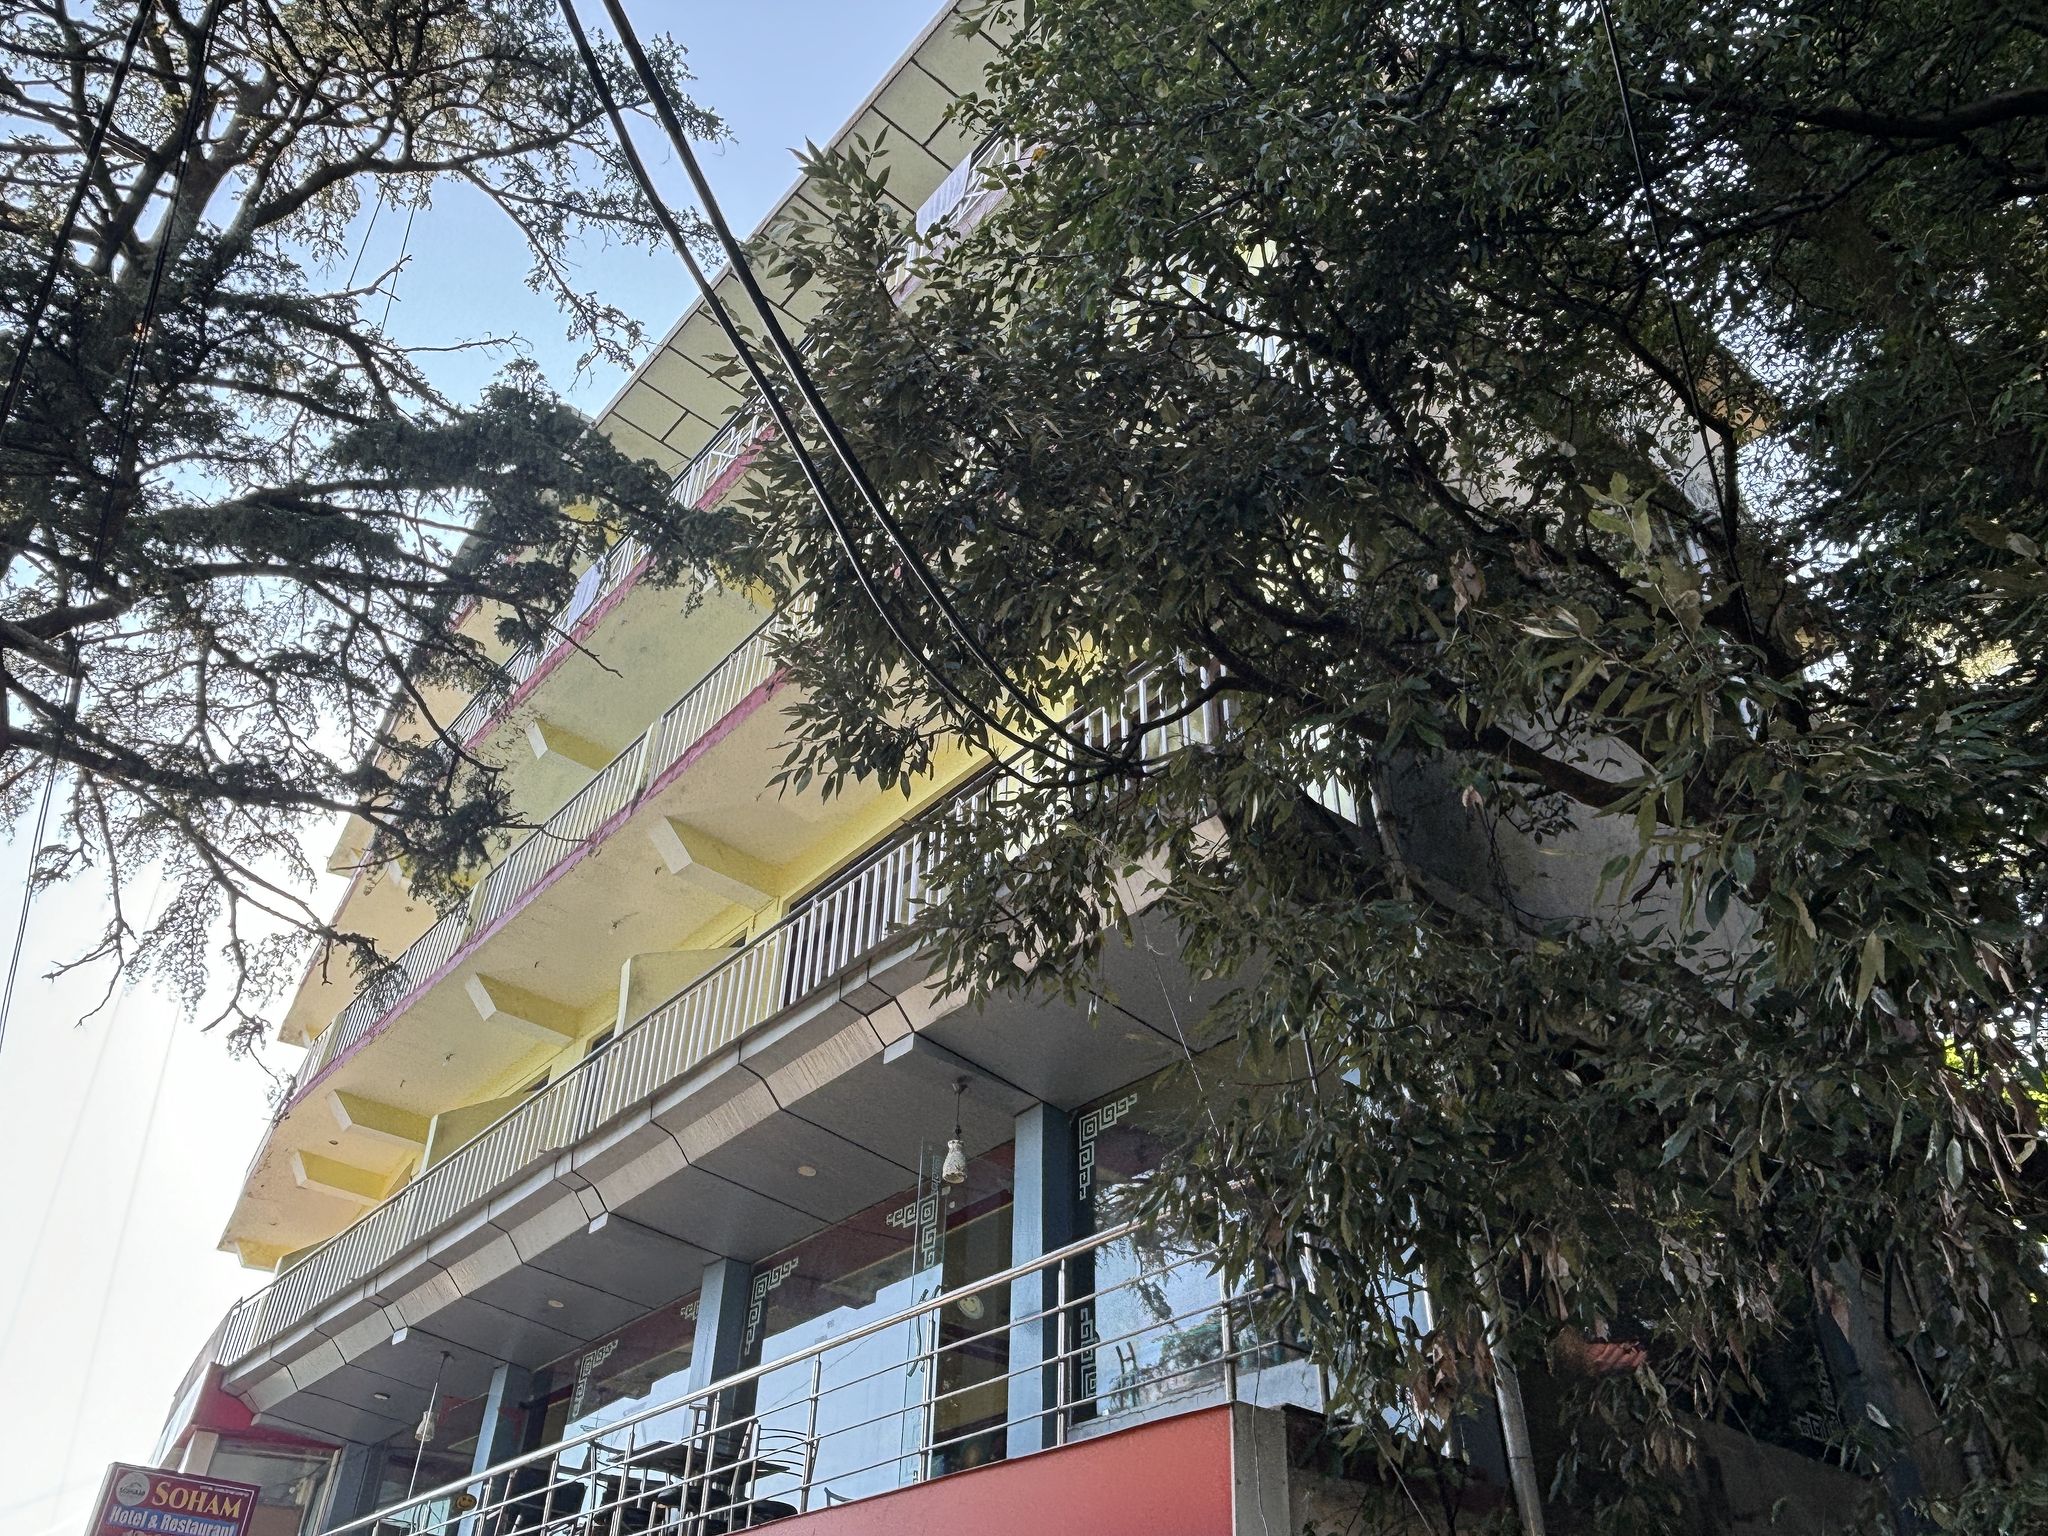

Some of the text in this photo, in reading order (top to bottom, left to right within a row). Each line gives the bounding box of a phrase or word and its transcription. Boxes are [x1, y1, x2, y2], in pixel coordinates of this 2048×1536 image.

[152, 1482, 242, 1518] SOHAM
[110, 1505, 235, 1536] Hotel & Restaurant
